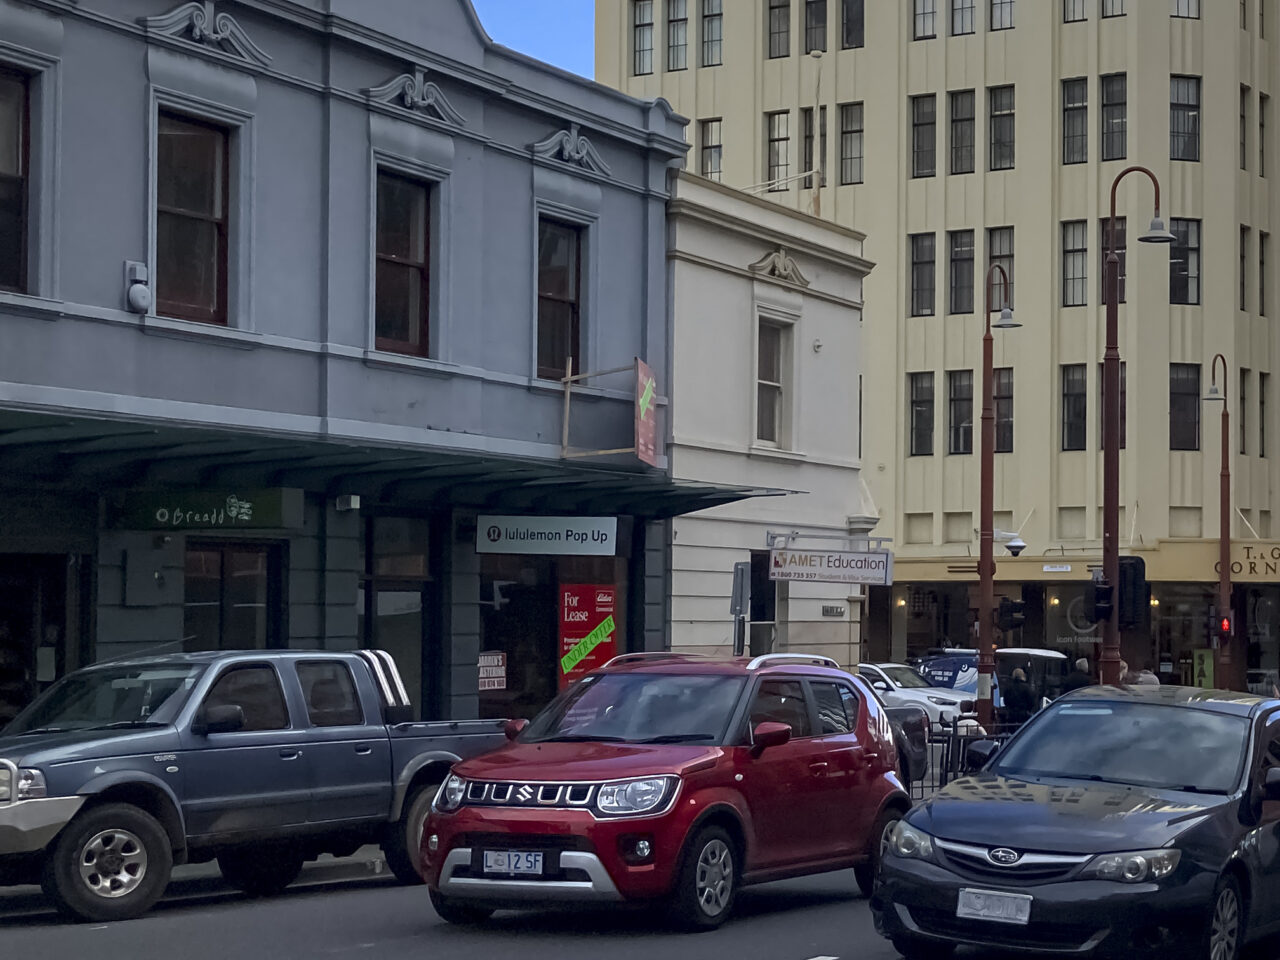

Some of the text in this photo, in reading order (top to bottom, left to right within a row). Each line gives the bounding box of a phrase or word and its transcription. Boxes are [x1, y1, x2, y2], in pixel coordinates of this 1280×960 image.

[505, 527, 608, 544] lululemon Pop Up
[788, 554, 885, 570] AMET Education
[564, 592, 579, 607] For
[564, 608, 589, 622] Lease
[562, 618, 613, 671] UNDER OFFER
[485, 852, 493, 868] L
[525, 853, 542, 869] SF
